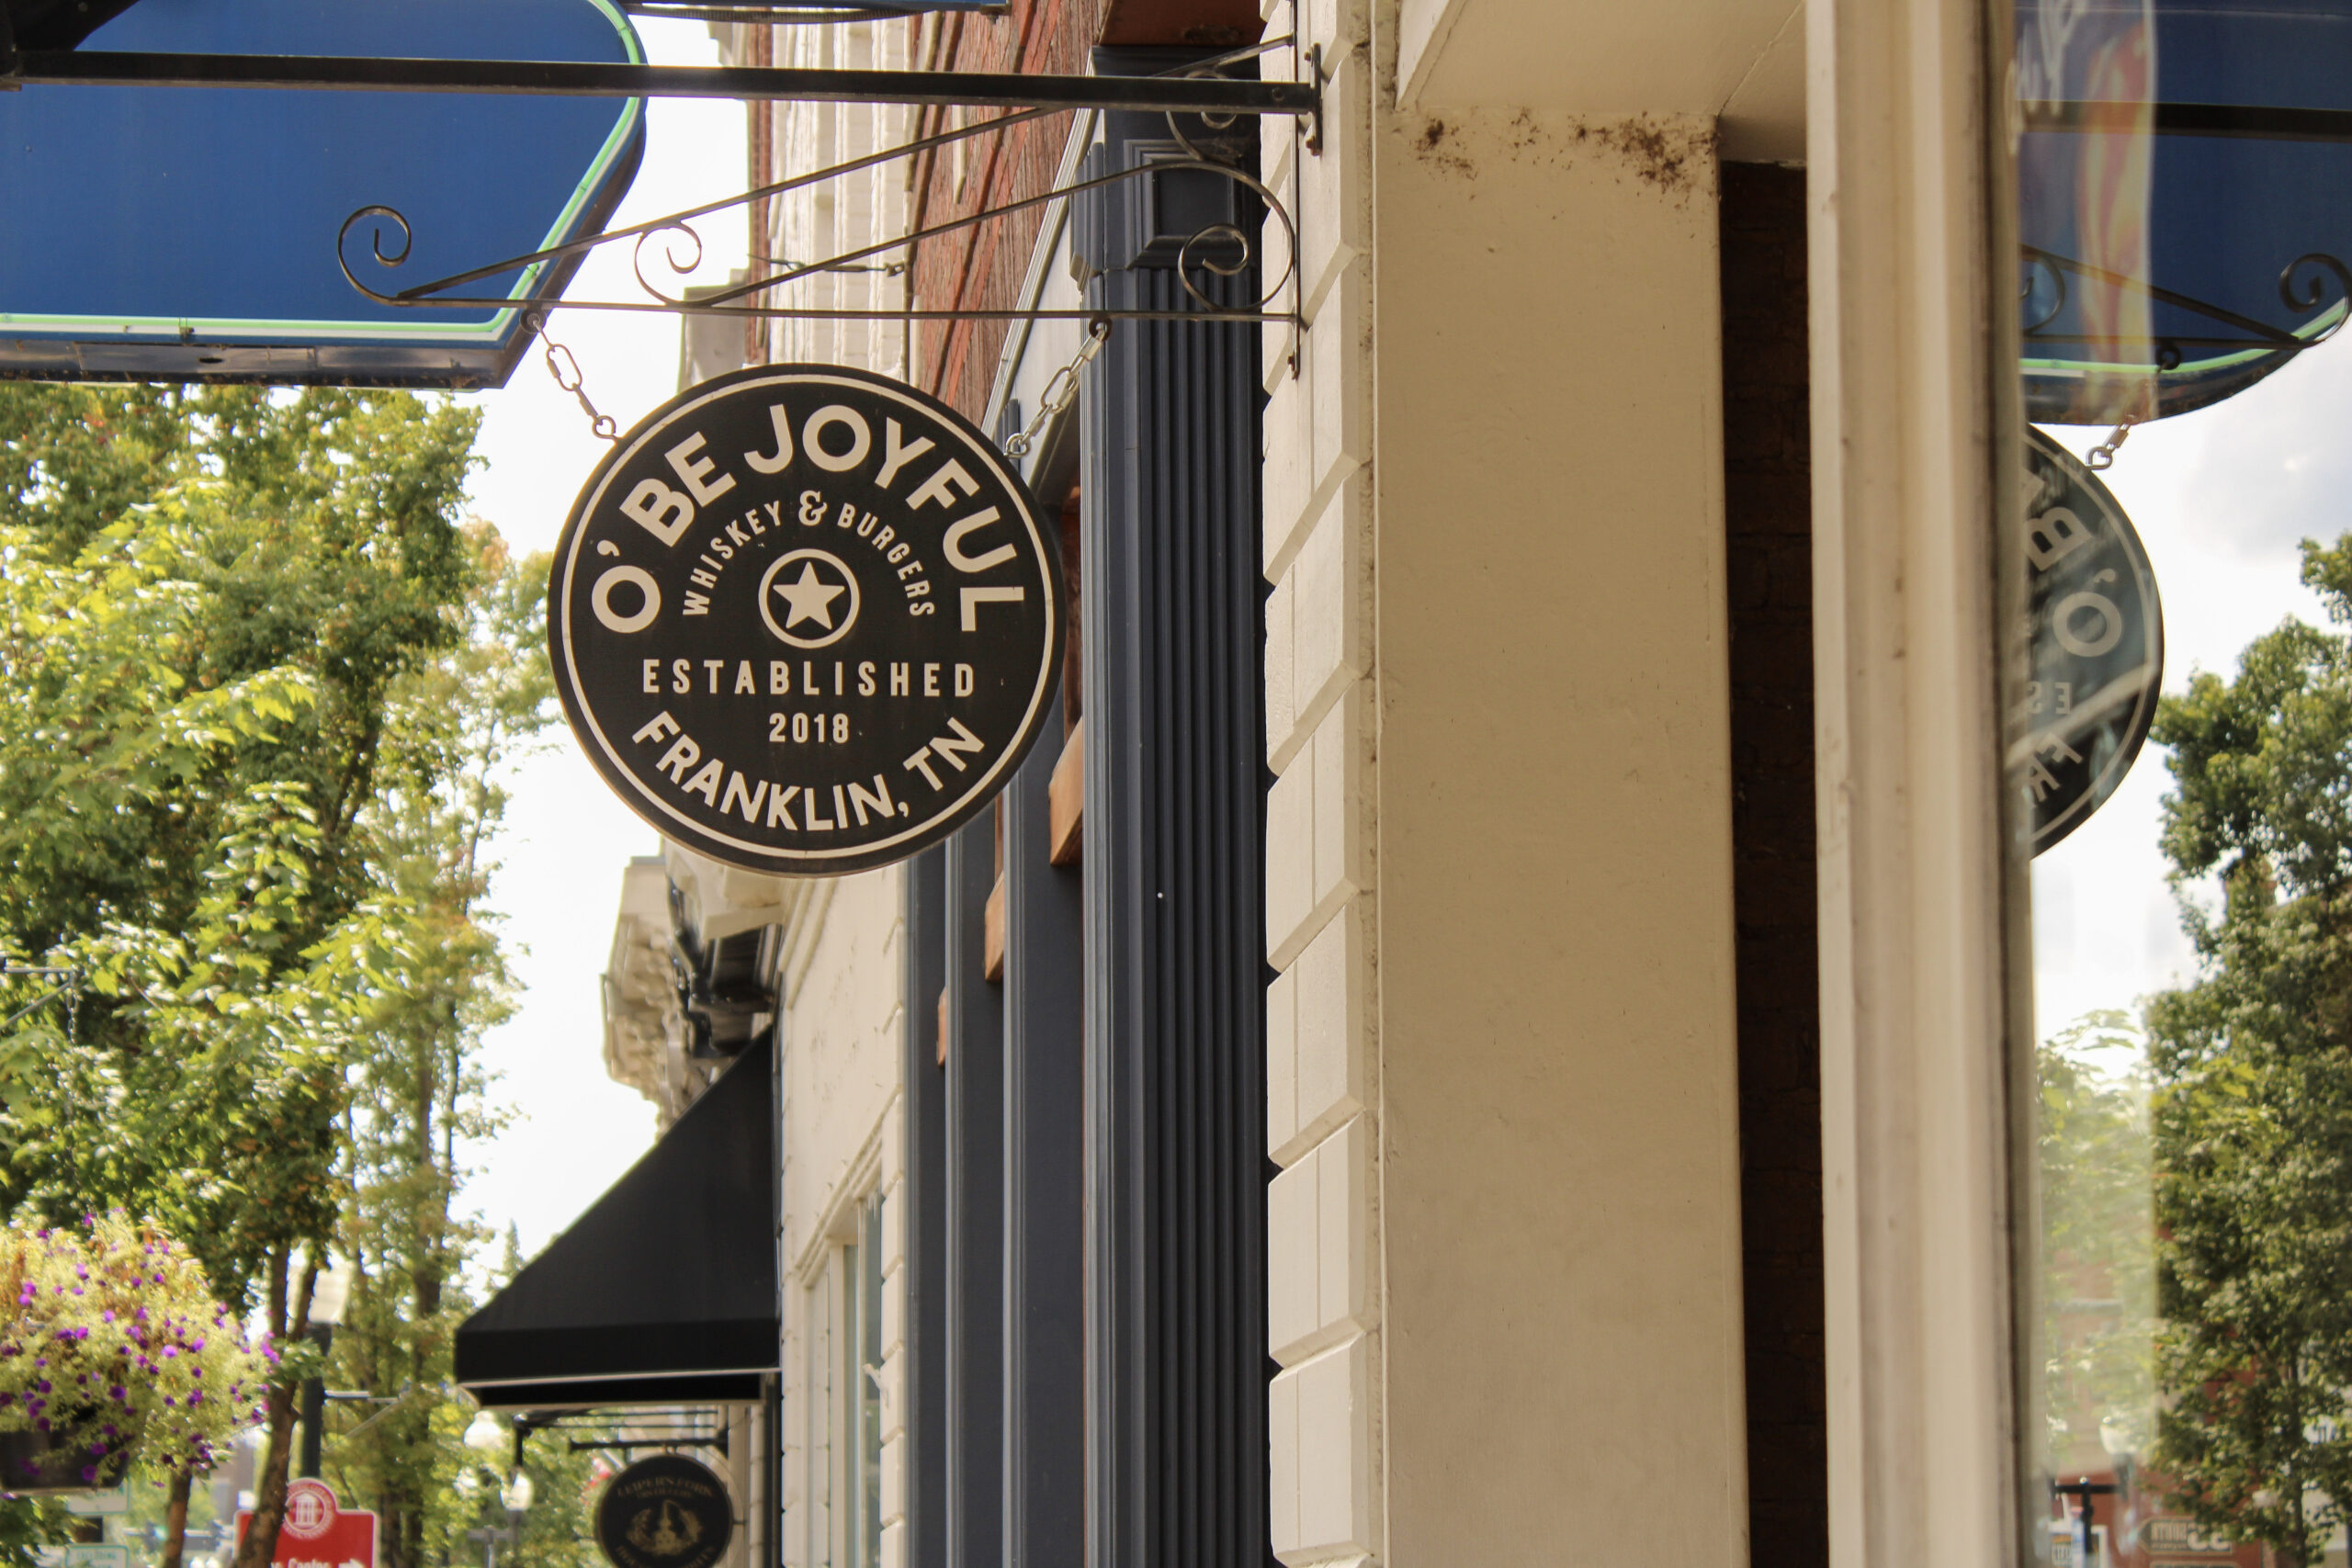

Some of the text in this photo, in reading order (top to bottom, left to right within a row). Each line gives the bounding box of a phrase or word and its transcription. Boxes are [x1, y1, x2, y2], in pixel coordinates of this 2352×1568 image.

[591, 403, 1024, 634] O' BE JOYFUL
[682, 490, 935, 617] WHISKEY & BURGERS
[643, 659, 974, 698] ESTABLISHED
[769, 712, 850, 744] 2018
[631, 710, 985, 831] FRANKLIN, TN
